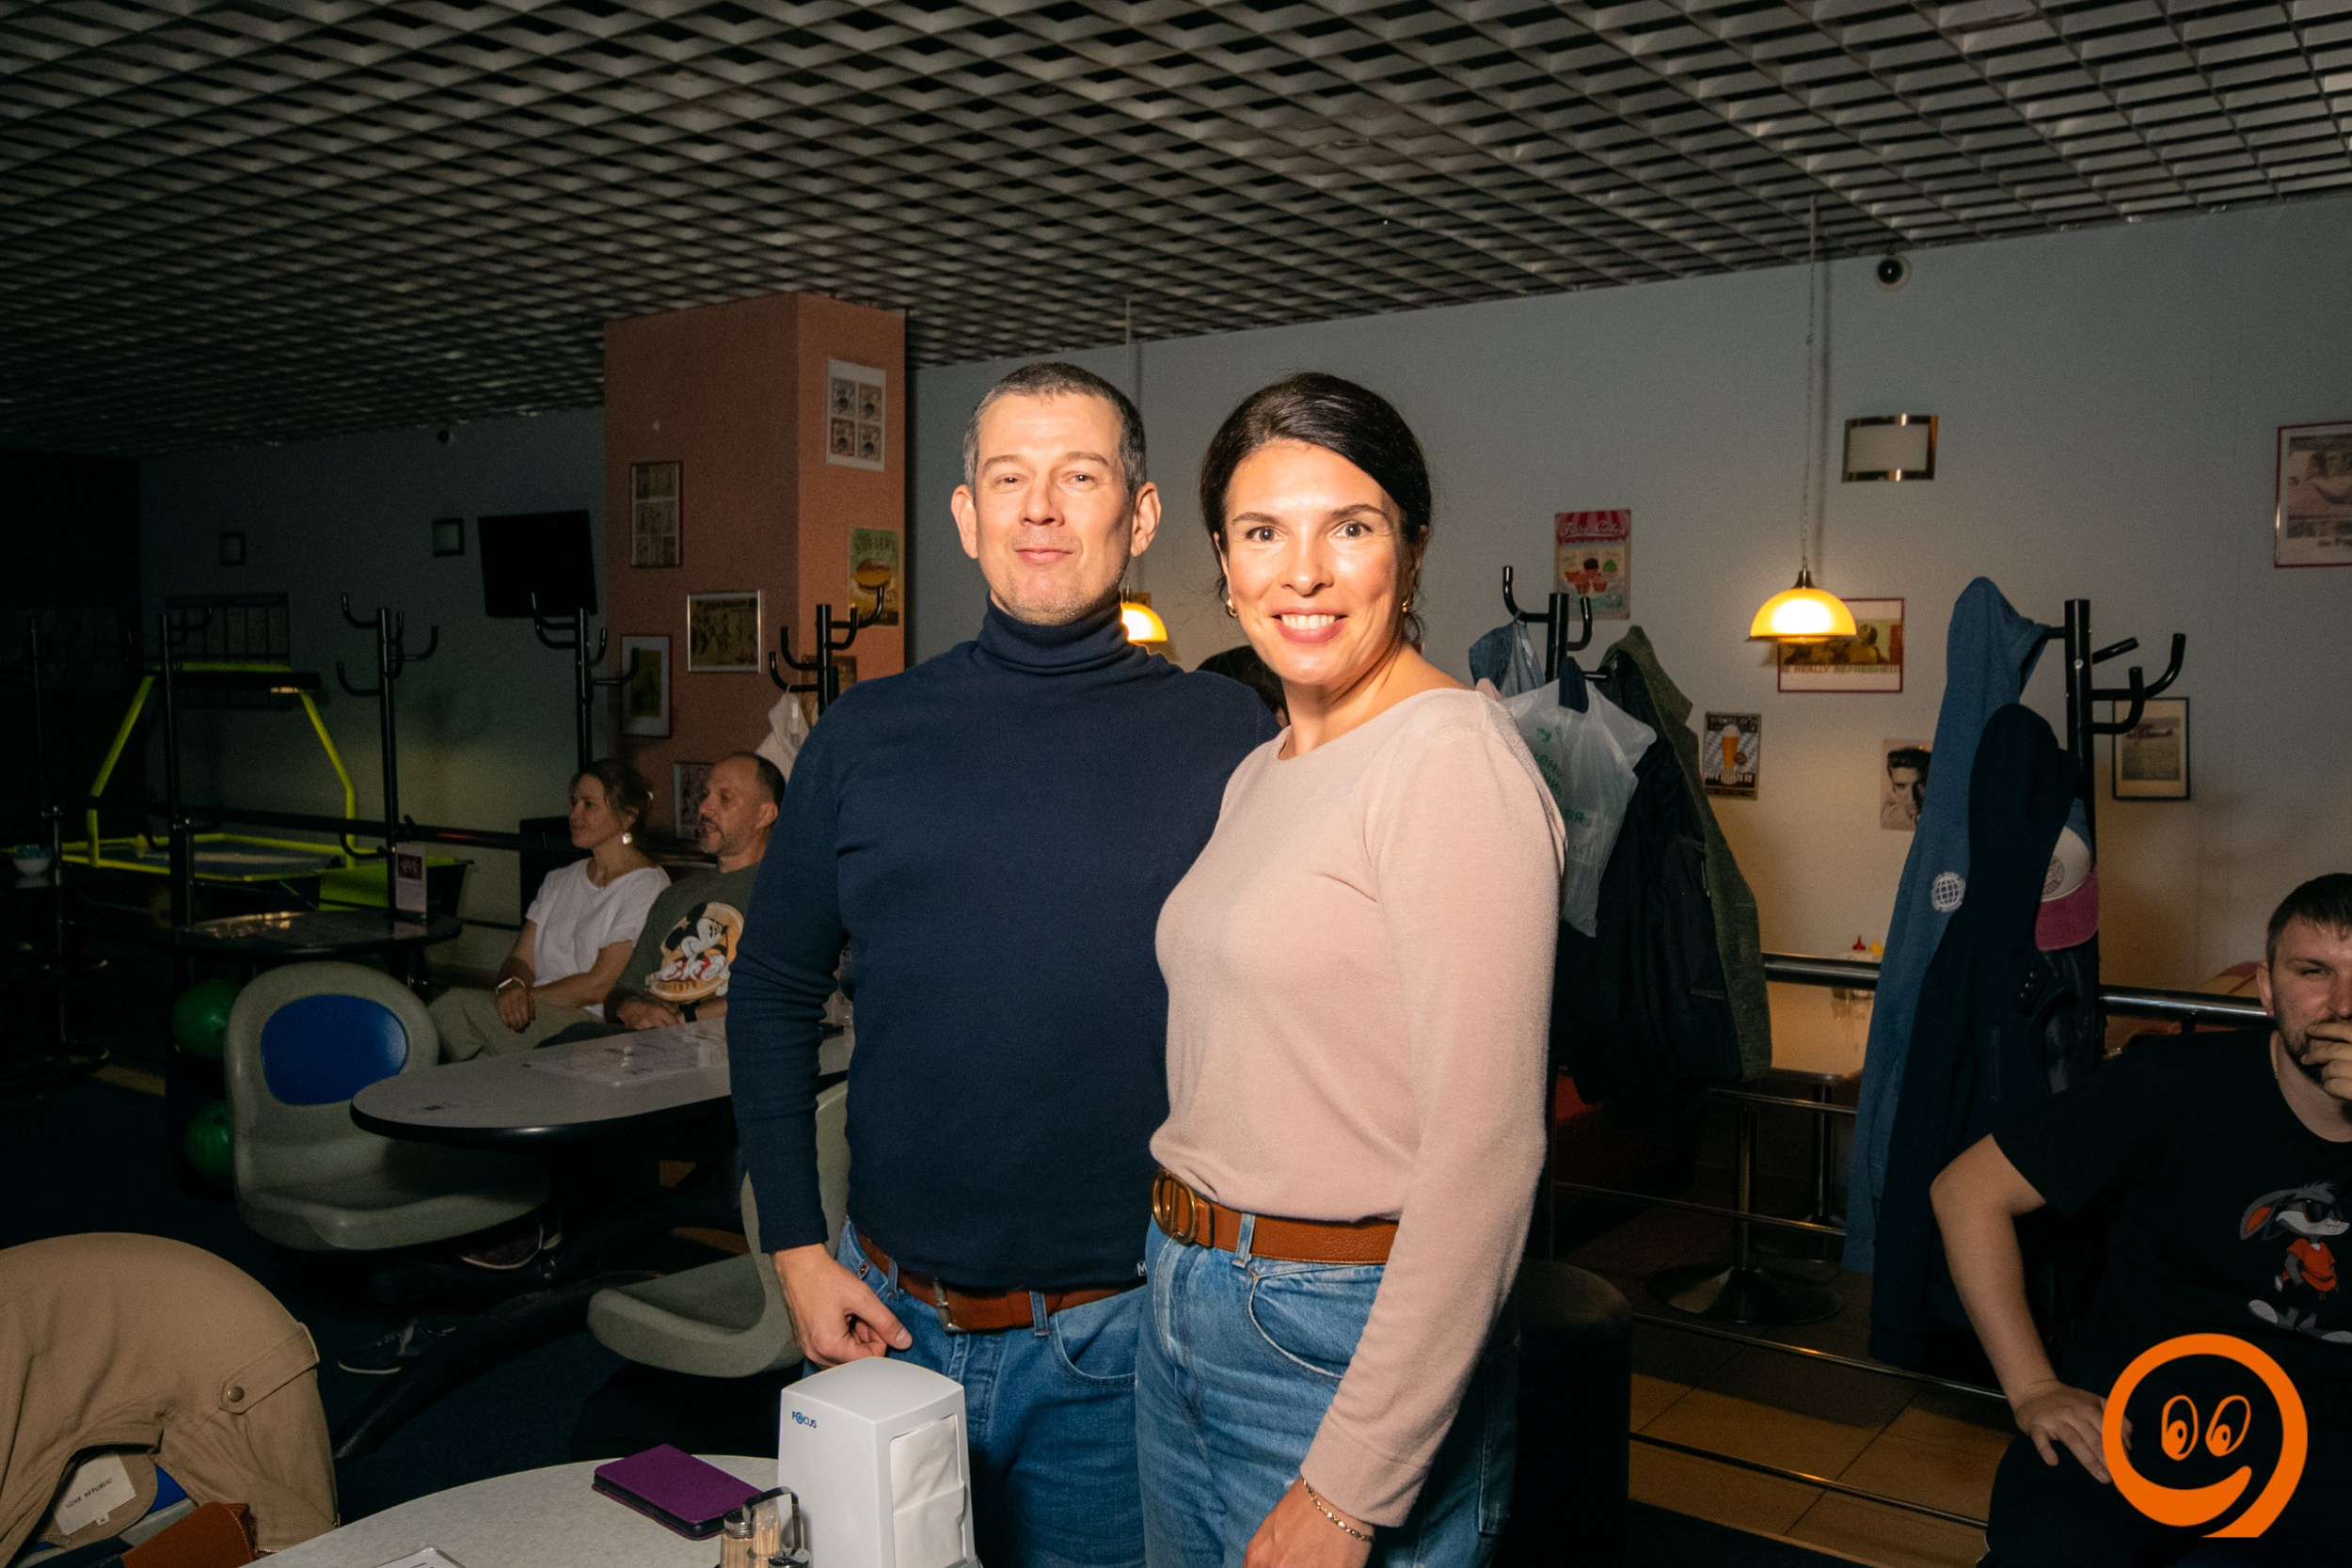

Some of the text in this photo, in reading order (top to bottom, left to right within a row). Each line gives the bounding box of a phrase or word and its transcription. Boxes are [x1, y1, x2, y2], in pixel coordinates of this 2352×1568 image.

[791, 1411, 817, 1429] FOCUS
[66, 1478, 113, 1509] LOVE REPUBLIC
